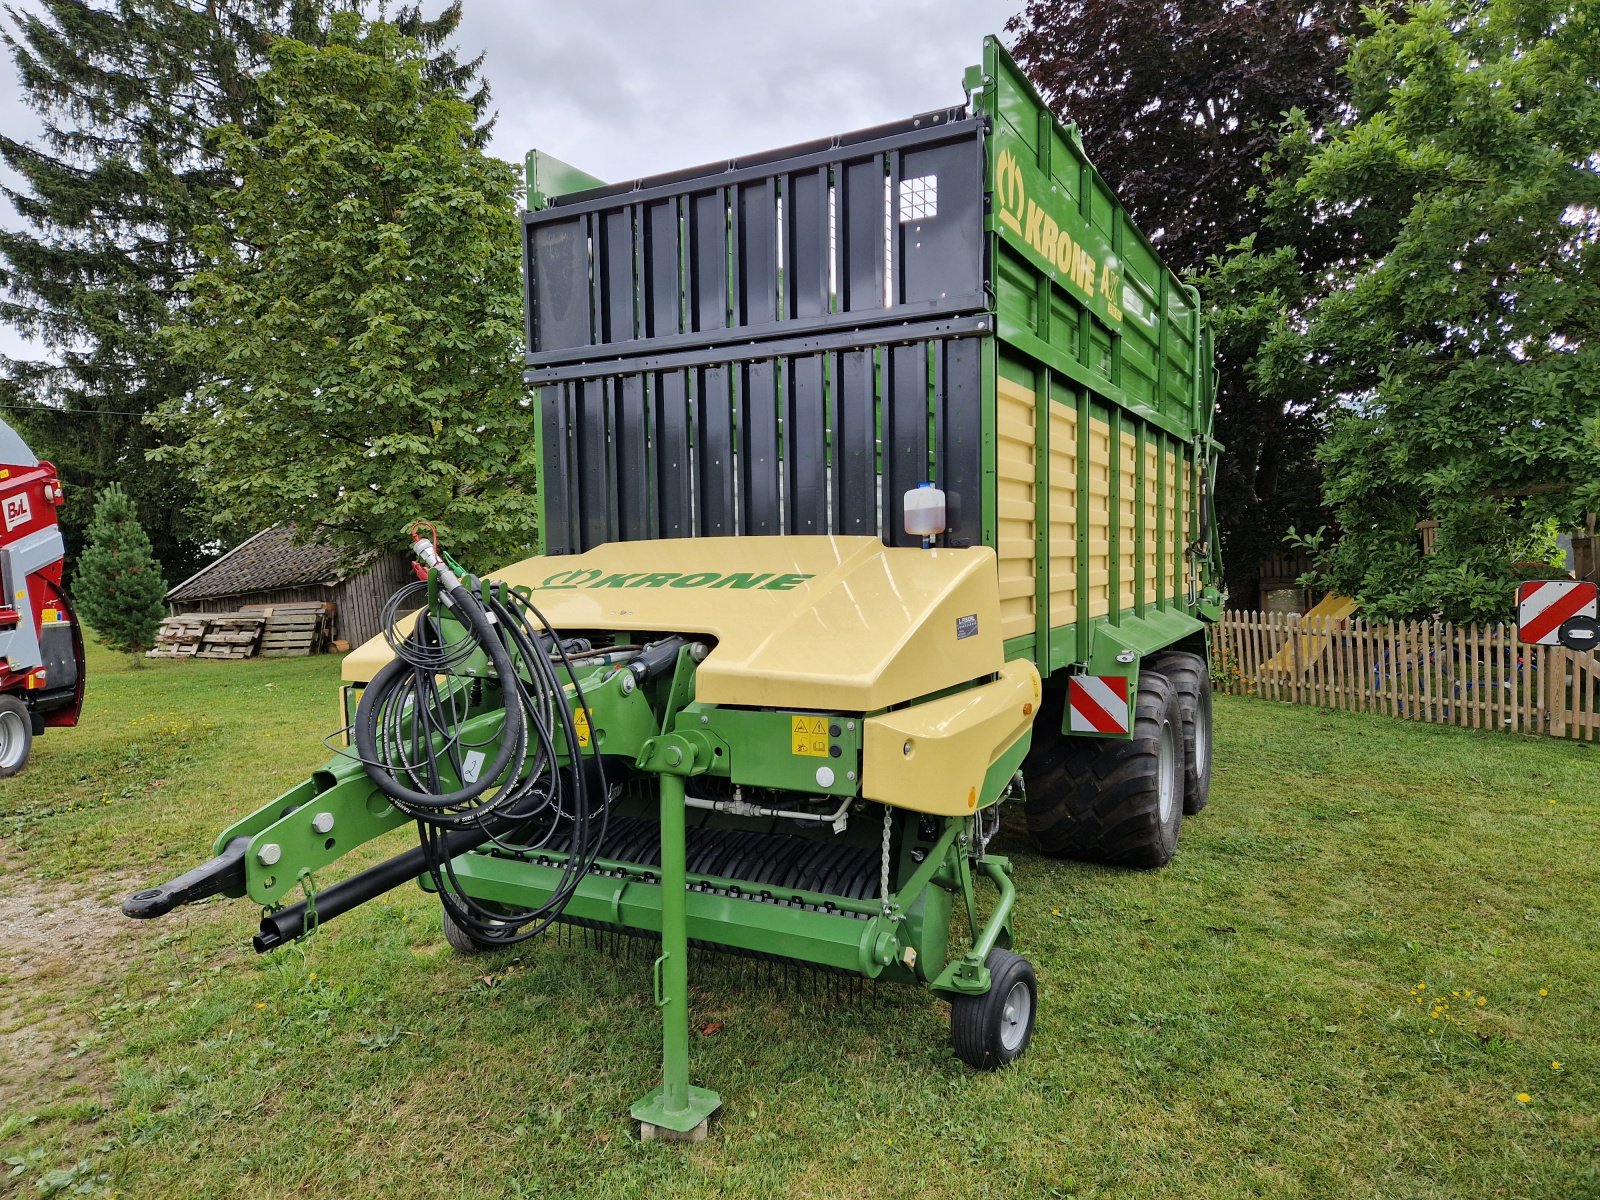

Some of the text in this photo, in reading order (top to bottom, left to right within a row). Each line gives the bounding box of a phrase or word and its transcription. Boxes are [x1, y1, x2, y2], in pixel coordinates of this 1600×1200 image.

[1025, 198, 1096, 298] KRONE
[586, 573, 816, 591] KRONE
[465, 760, 477, 777] 2
